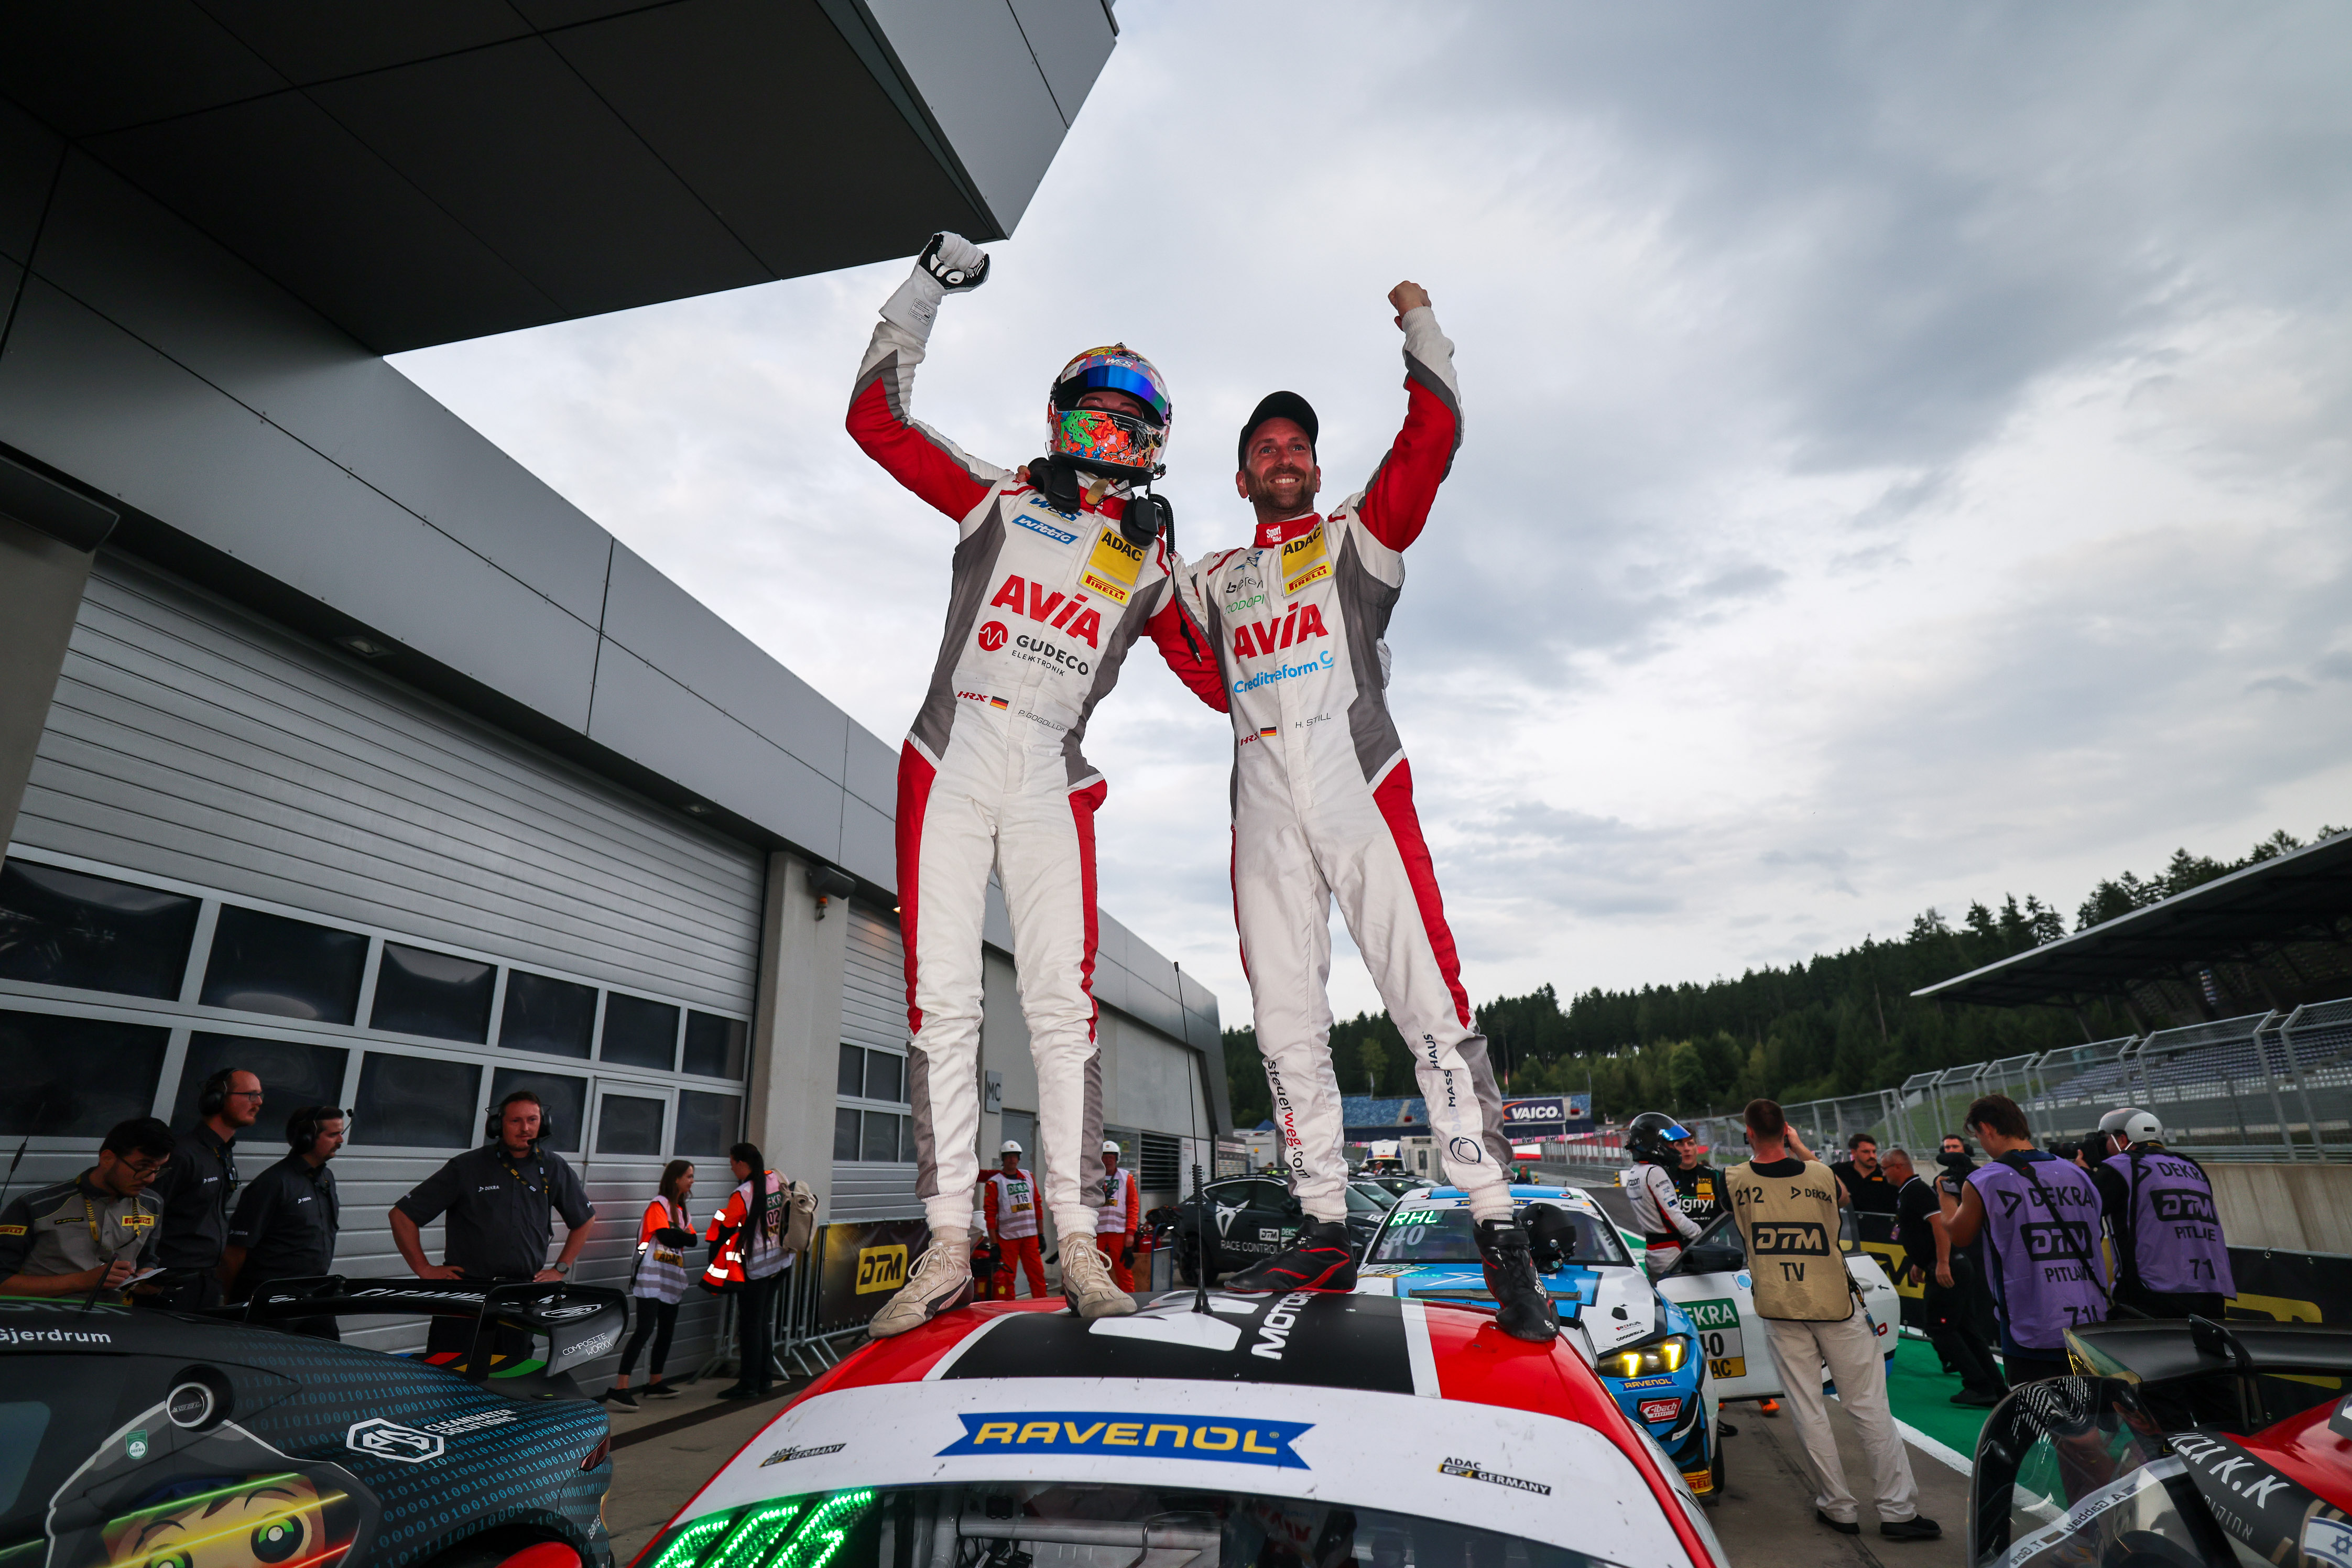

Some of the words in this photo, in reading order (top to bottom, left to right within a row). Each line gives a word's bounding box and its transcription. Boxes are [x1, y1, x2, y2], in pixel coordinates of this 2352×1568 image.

[1018, 518, 1071, 541] wittig
[1266, 525, 1281, 539] Sport
[1102, 531, 1142, 562] ADAC
[1283, 527, 1321, 556] ADAC
[1085, 574, 1126, 601] PIRELLI
[1289, 565, 1327, 591] PIRELLI
[1012, 650, 1065, 677] ELEKTRONIK
[1016, 635, 1088, 675] GUDECO
[1234, 661, 1318, 693] Creditreform
[957, 691, 989, 702] HRX
[1306, 713, 1331, 726] STILL
[1423, 1033, 1440, 1069] HAUS
[1268, 1060, 1311, 1180] steuerweg.com
[1511, 1105, 1559, 1120] VAICO
[2157, 1162, 2208, 1182] DEKR
[767, 1195, 782, 1207] EKR
[1735, 1186, 1764, 1206] 212
[1805, 1188, 1832, 1203] DEKRA
[2028, 1186, 2094, 1208] DEKRA
[2162, 1194, 2214, 1219] DTM
[1389, 1211, 1438, 1226] RHL
[1389, 1225, 1426, 1246] 40
[1756, 1228, 1823, 1250] DTM
[1220, 1239, 1240, 1251] RACE
[1242, 1242, 1279, 1254] CONTROL
[859, 1253, 903, 1286] DTM
[1779, 1262, 1804, 1281] TV
[2189, 1259, 2216, 1279] 71
[1681, 1304, 1737, 1326] EKRA
[562, 1333, 607, 1356] COMPOSITE
[585, 1339, 612, 1356] WORXX
[1624, 1378, 1672, 1389] RAVENOL
[424, 1409, 517, 1432] CLEANWATER
[439, 1415, 519, 1436] SOLUTIONS
[973, 1421, 1278, 1455] RAVENOL
[770, 1445, 801, 1458] ADAC
[789, 1444, 844, 1460] GERMANY
[1444, 1457, 1482, 1469] ADAC
[1478, 1472, 1548, 1494] GERMANY
